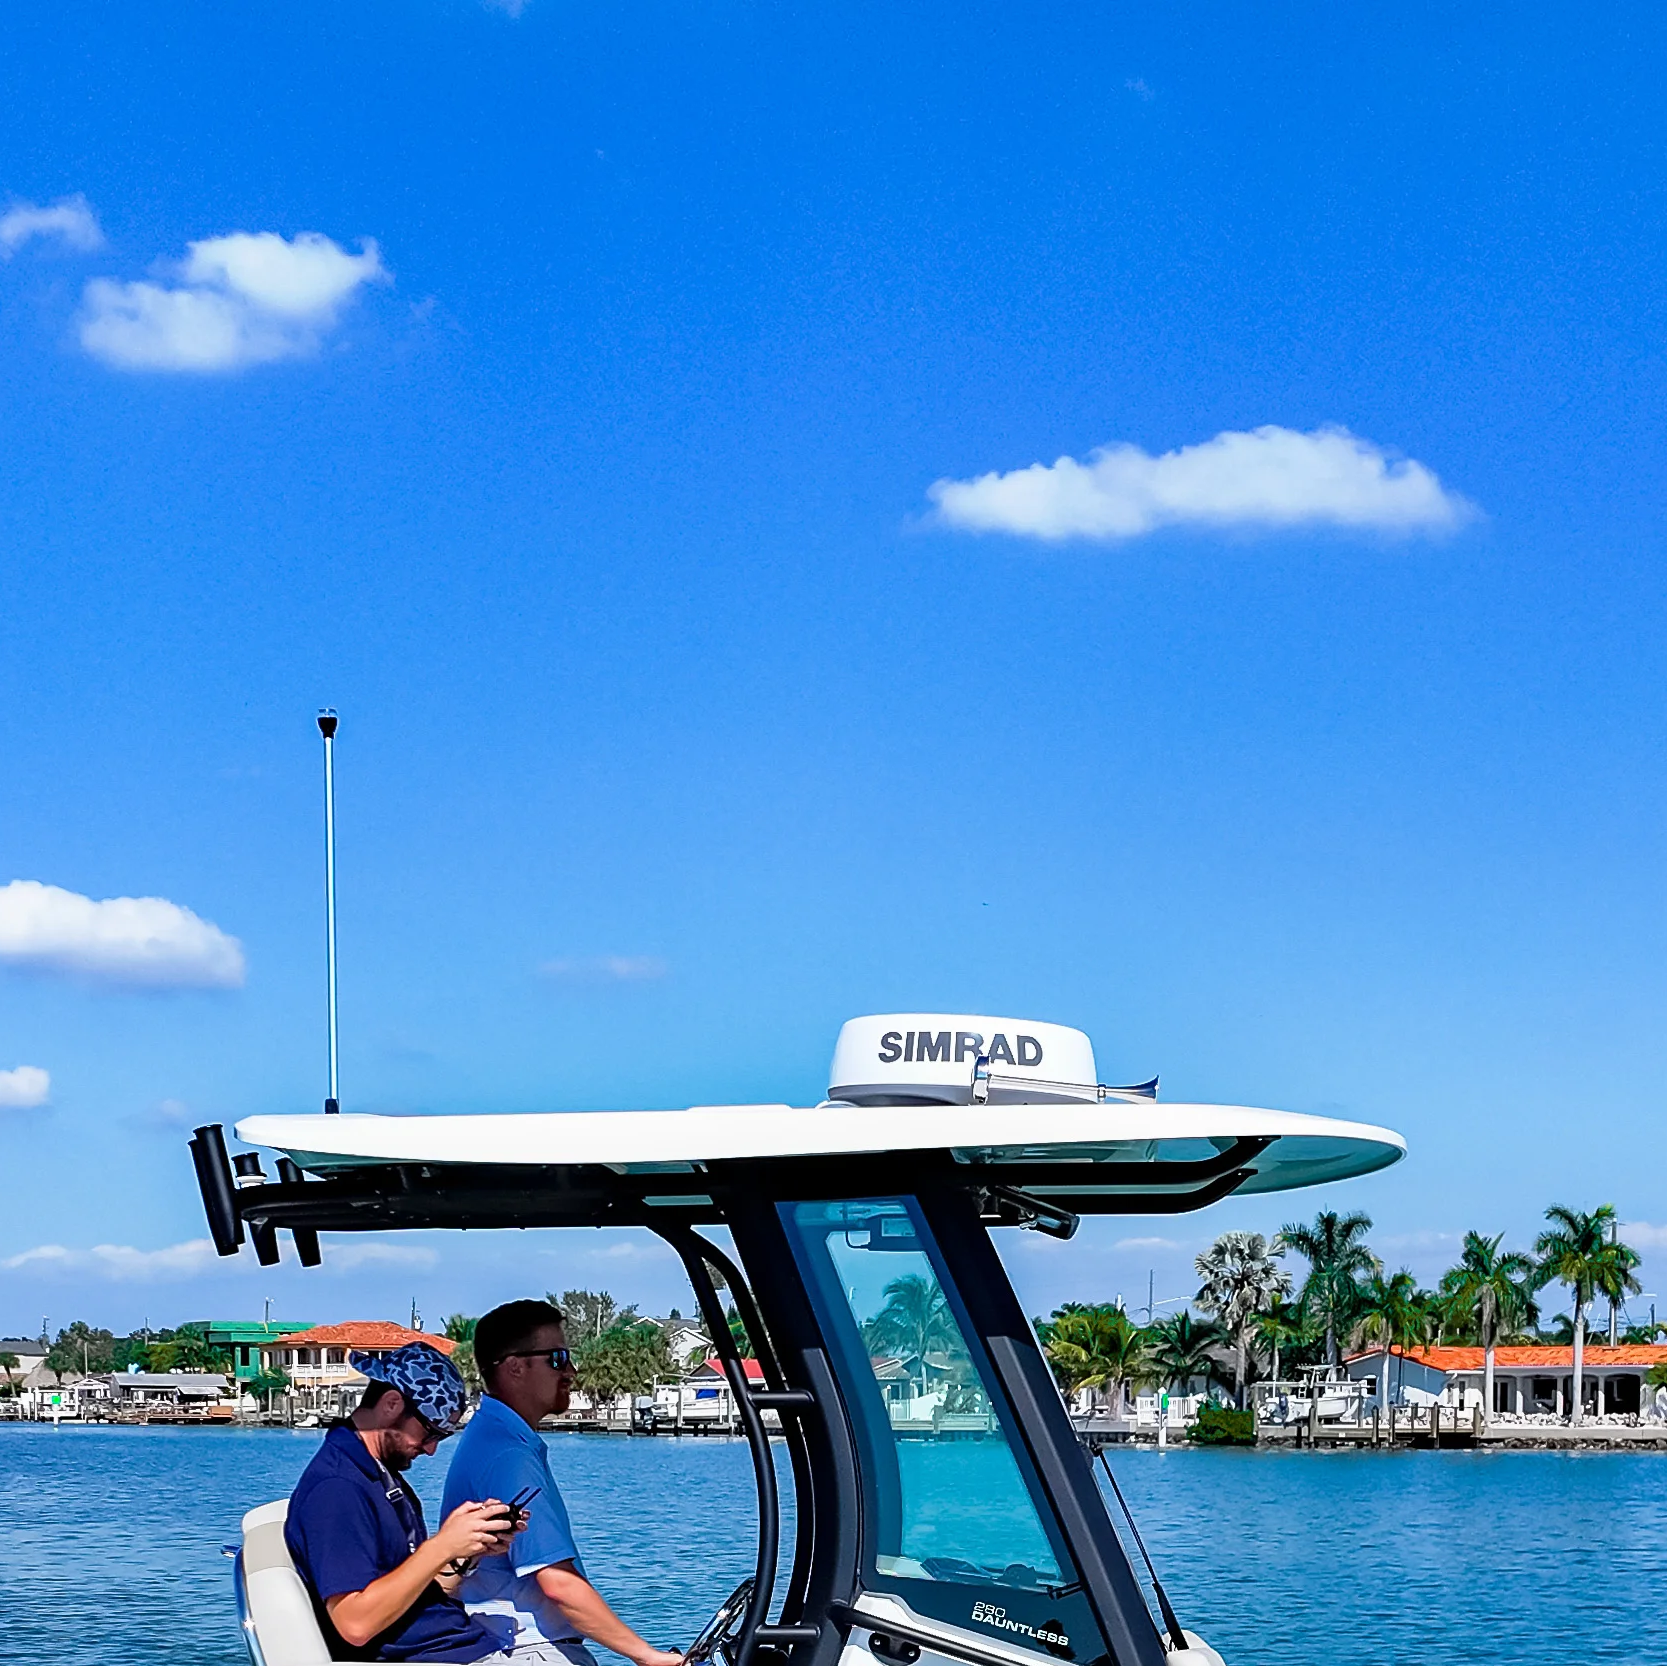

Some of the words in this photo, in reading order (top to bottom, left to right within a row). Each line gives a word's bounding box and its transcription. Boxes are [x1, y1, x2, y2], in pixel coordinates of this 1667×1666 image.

[878, 1031, 1043, 1066] SIMRAD
[973, 1601, 1006, 1618] 280
[971, 1610, 1069, 1646] DAUNTLESS
